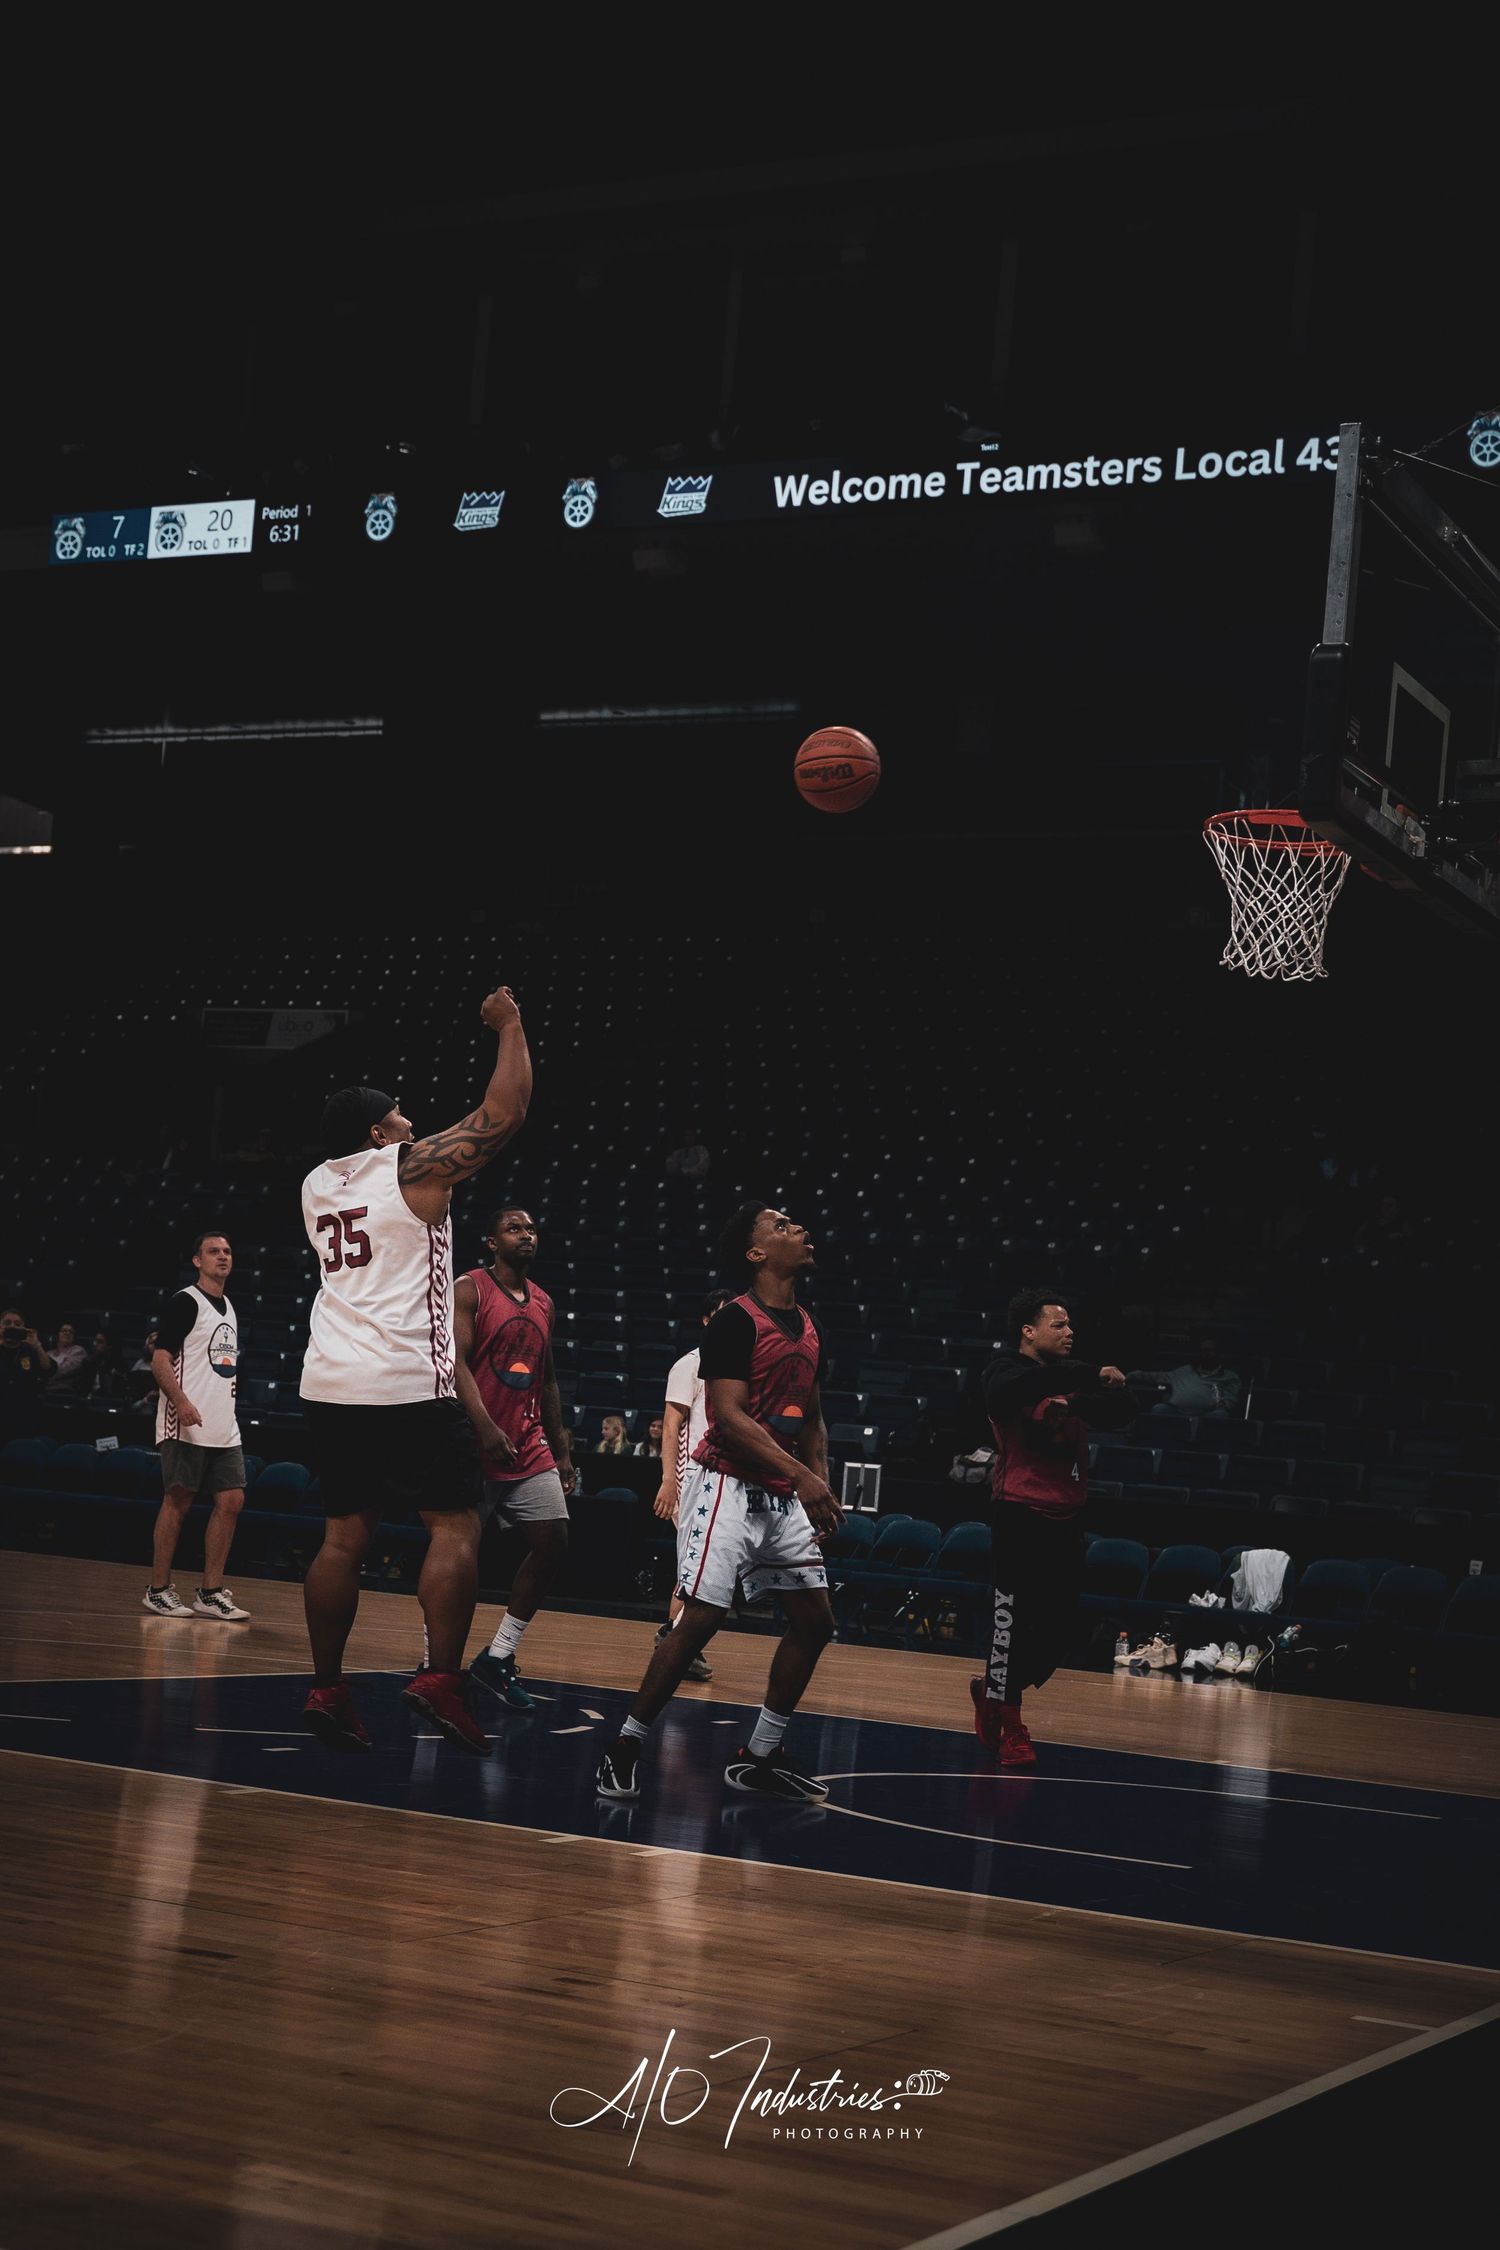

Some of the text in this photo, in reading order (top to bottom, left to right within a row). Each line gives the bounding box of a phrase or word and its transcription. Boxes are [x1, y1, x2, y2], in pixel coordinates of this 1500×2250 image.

[773, 470, 946, 508] Welcome
[956, 455, 1163, 495] Teamsters
[1175, 438, 1286, 481] Local
[262, 504, 312, 520] Period 1
[661, 497, 704, 512] Kings
[112, 515, 126, 540] 7
[206, 508, 234, 532] 20
[457, 511, 497, 525] Kings
[187, 536, 248, 552] TOL 0 TF 1
[269, 525, 300, 544] 6:31
[86, 544, 145, 559] TOL 0 TF 2
[316, 1205, 373, 1274] 35
[1071, 1462, 1080, 1481] 4
